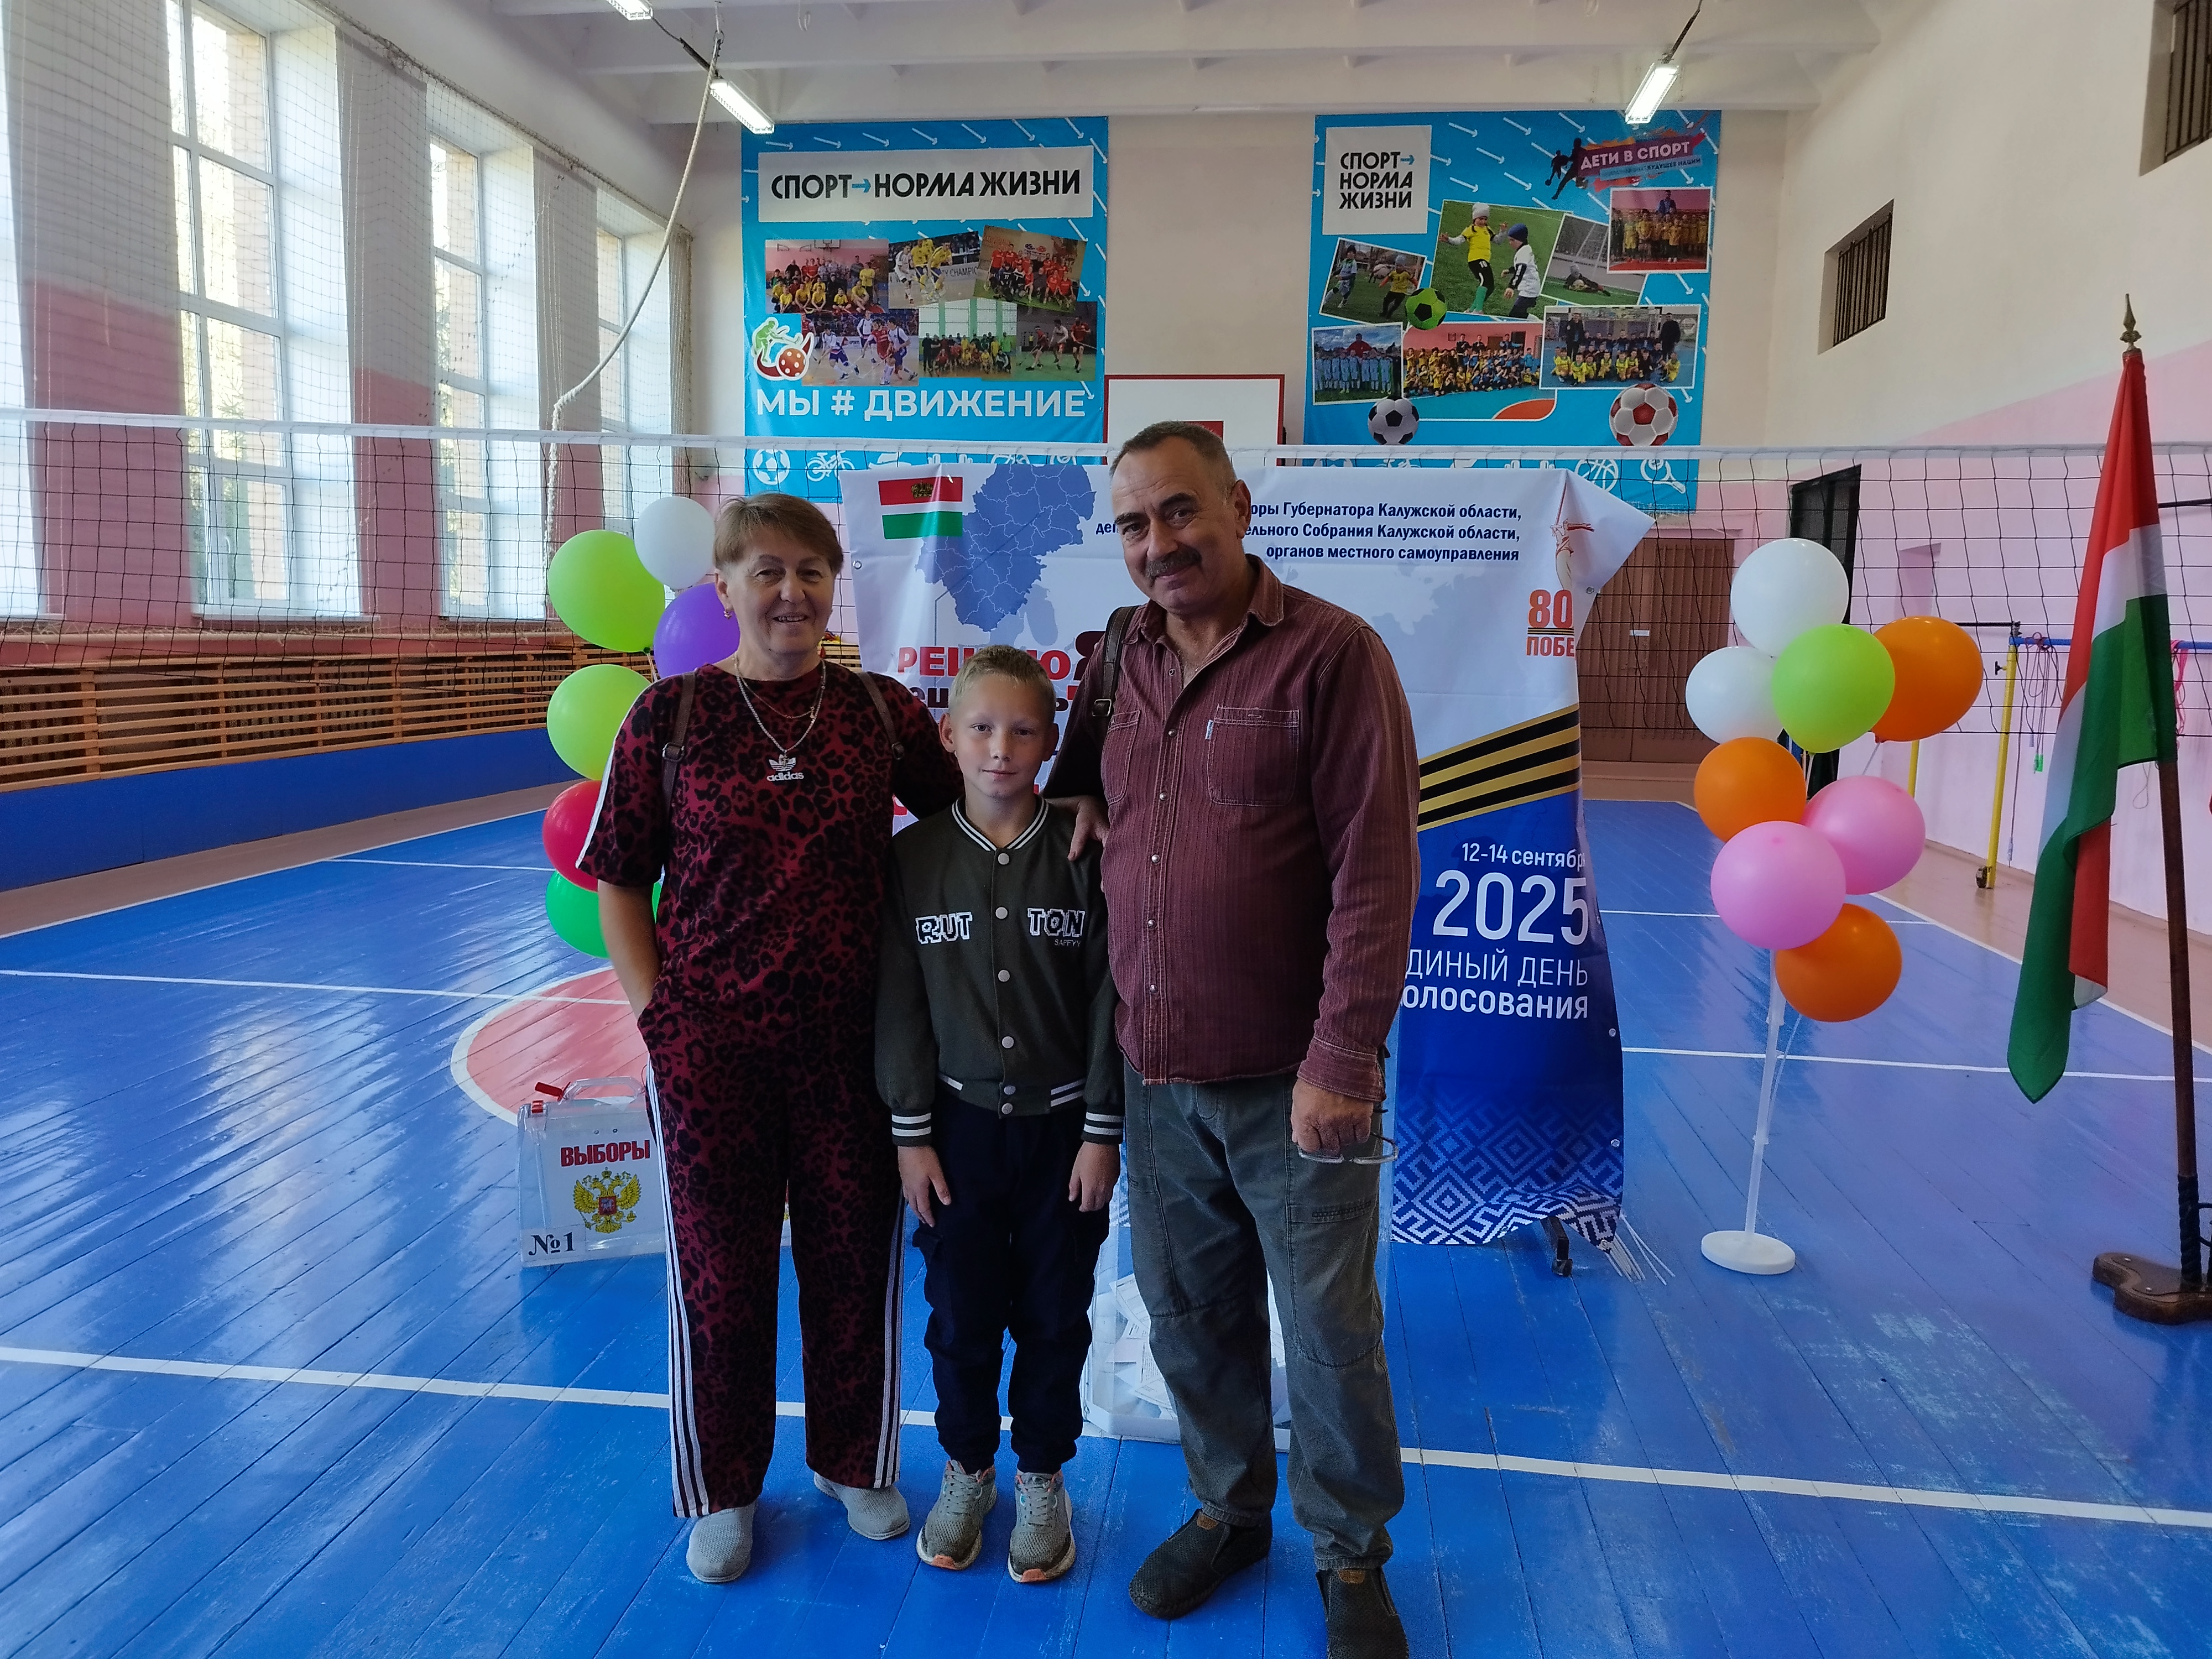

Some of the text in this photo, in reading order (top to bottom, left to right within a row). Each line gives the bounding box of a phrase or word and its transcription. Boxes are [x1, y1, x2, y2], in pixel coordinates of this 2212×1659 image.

[1340, 151, 1401, 170] СПОРТ
[1580, 142, 1690, 170] ДЕТИ В СПОРТ
[771, 169, 1080, 199] СПОРТ НОРМА ЖИЗНИ
[1339, 171, 1413, 190] НОРМА
[1338, 191, 1412, 210] ЖИЗНИ
[757, 389, 1086, 422] МЫ # ДВИЖЕНИЕ
[1283, 501, 1374, 519] Губернатора
[1378, 503, 1455, 520] Калужской
[1459, 504, 1521, 521] области,
[1302, 523, 1373, 540] Собрания
[1377, 524, 1454, 541] Калужской
[1458, 525, 1520, 542] области,
[1266, 546, 1519, 563] органов местного самоуправления
[1528, 589, 1573, 628] 80
[1526, 637, 1575, 657] ПОБЕ
[766, 772, 805, 781] adidas
[1462, 842, 1508, 864] 12-14
[1433, 869, 1589, 945] 2025
[915, 907, 1086, 945] RUT TON
[1405, 948, 1588, 988] ДИНЫЙ ДЕНЬ
[1402, 984, 1588, 1019] олосования
[561, 1140, 650, 1167] ВЫБОРЫ
[528, 1232, 576, 1256] №1
